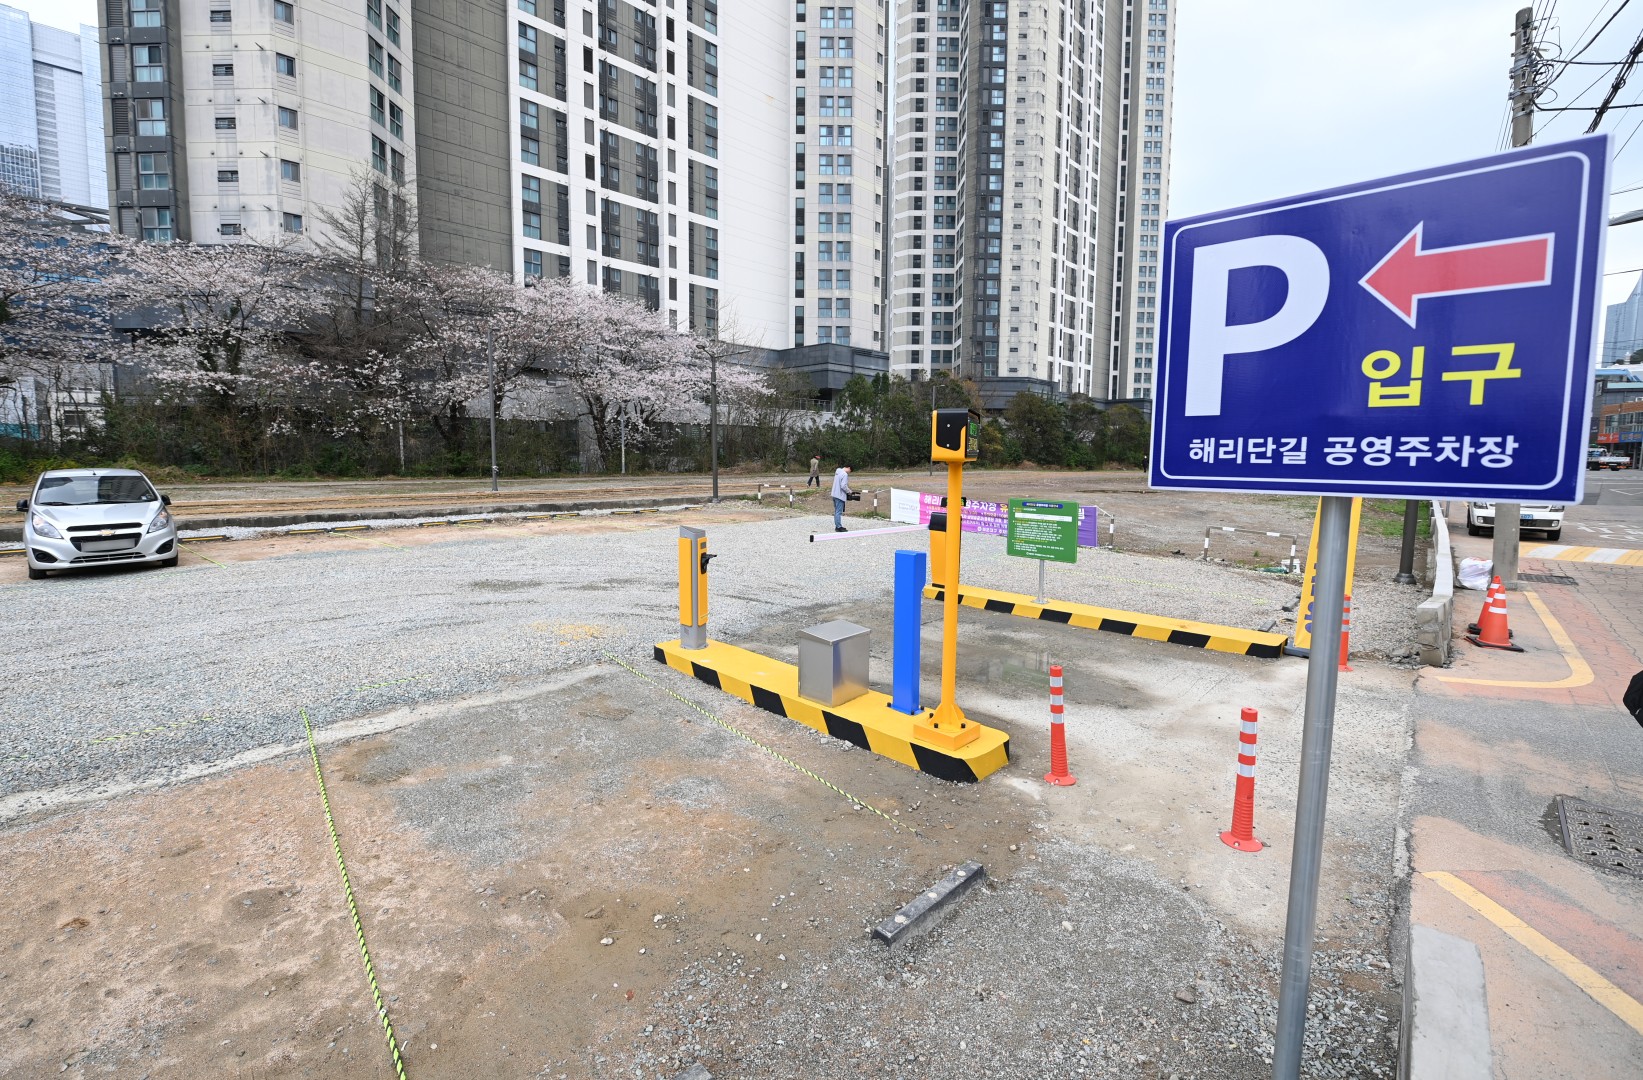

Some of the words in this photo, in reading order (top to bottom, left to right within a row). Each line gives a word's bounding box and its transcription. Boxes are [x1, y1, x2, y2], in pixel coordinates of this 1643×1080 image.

[1184, 234, 1331, 417] P
[1360, 342, 1522, 408] 입구
[1188, 435, 1308, 466] 해리단길
[1322, 433, 1520, 470] 공영주차장
